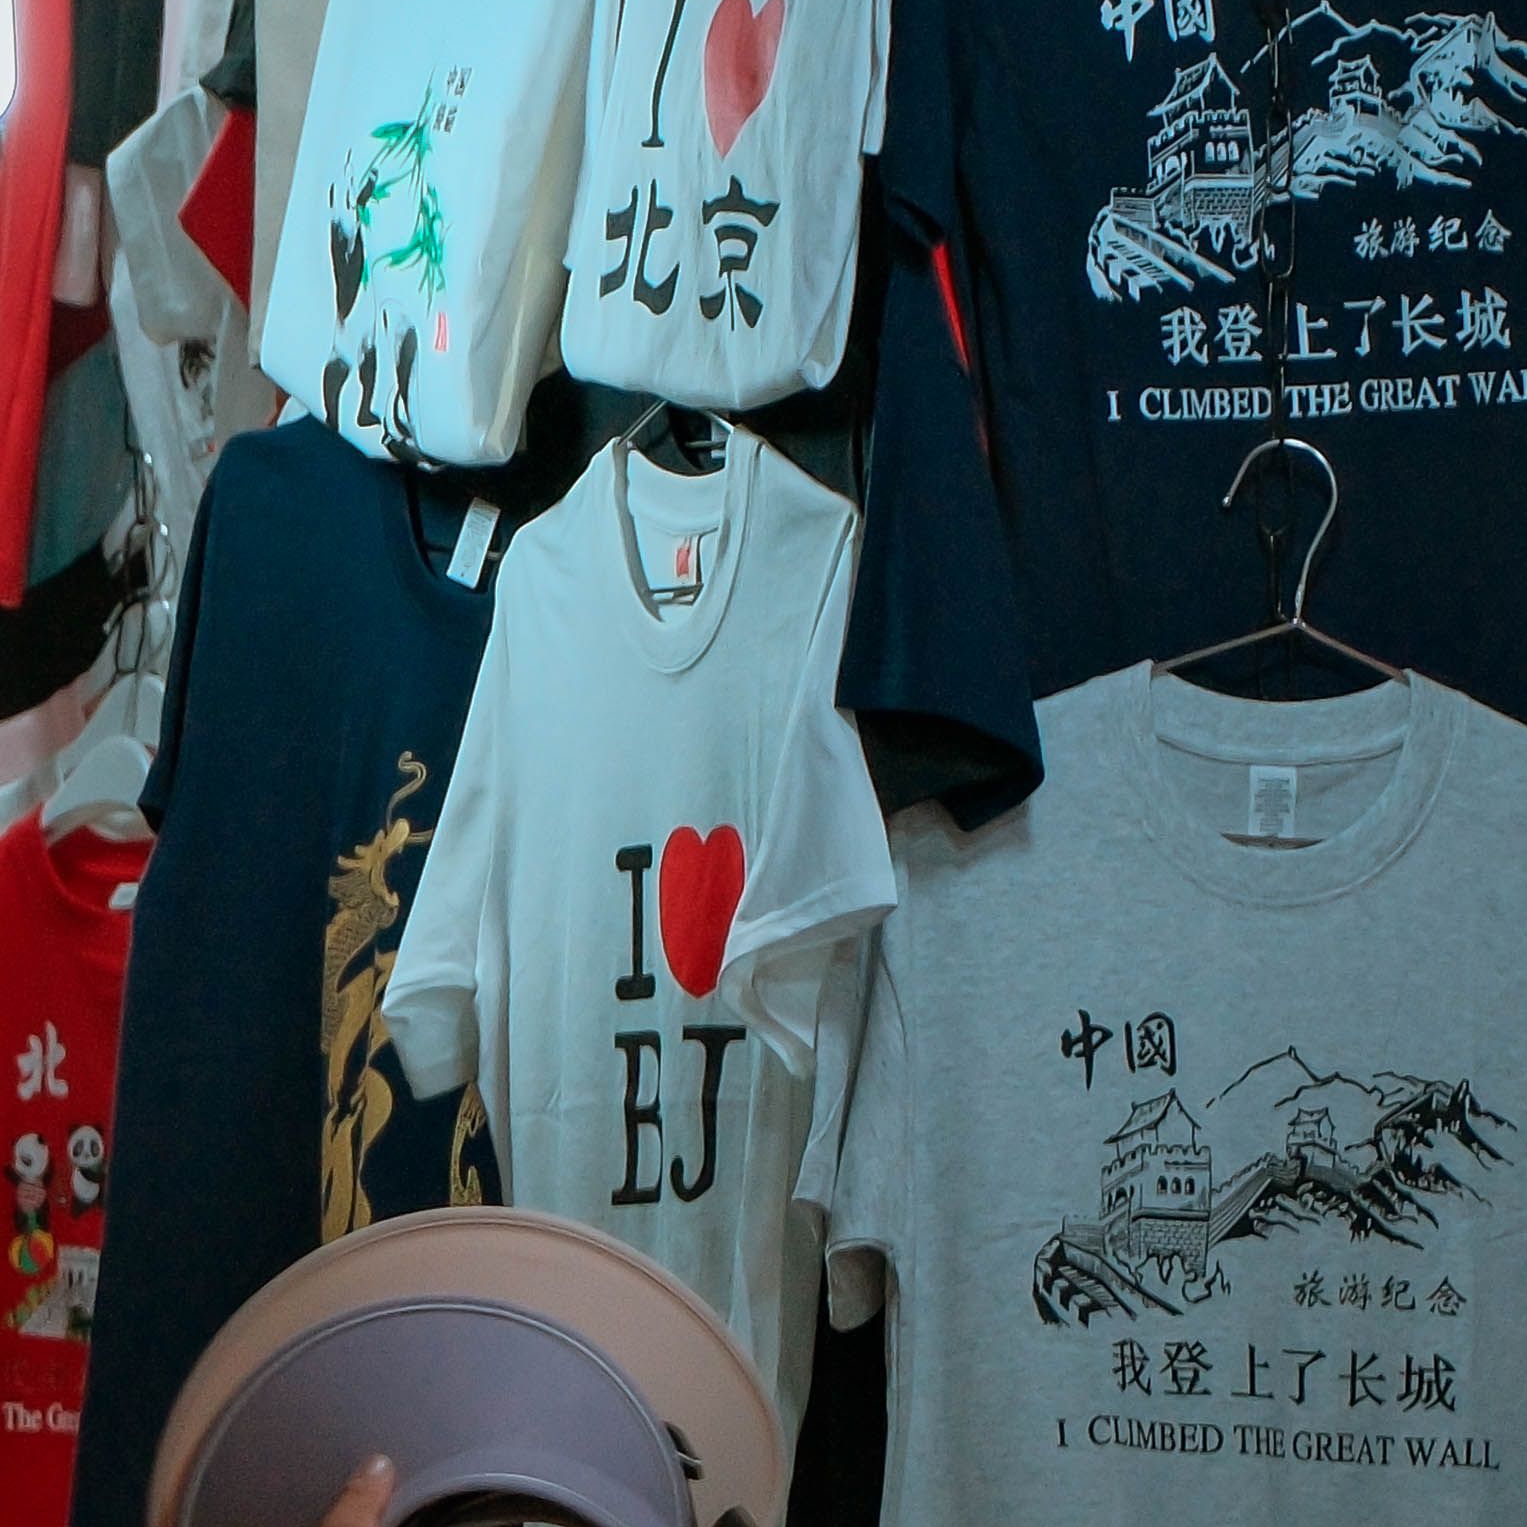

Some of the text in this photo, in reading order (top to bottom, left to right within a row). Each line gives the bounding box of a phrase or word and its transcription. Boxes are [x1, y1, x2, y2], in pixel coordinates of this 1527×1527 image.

[599, 175, 781, 332] 北京
[1160, 287, 1513, 366] 我登上了长城
[1107, 390, 1122, 422] I
[1139, 386, 1273, 422] CLIMBED
[1282, 382, 1353, 417] THE
[1359, 374, 1462, 412] GREAT
[615, 843, 656, 1000] I
[16, 1020, 70, 1101] 北
[611, 1024, 747, 1206] BJ
[1293, 1269, 1468, 1316] 旅游纪念
[1111, 1336, 1457, 1412] 我登上了长城
[3, 1401, 43, 1434] The
[1057, 1414, 1500, 1471] I CLIMBED THE GREAT WALL
